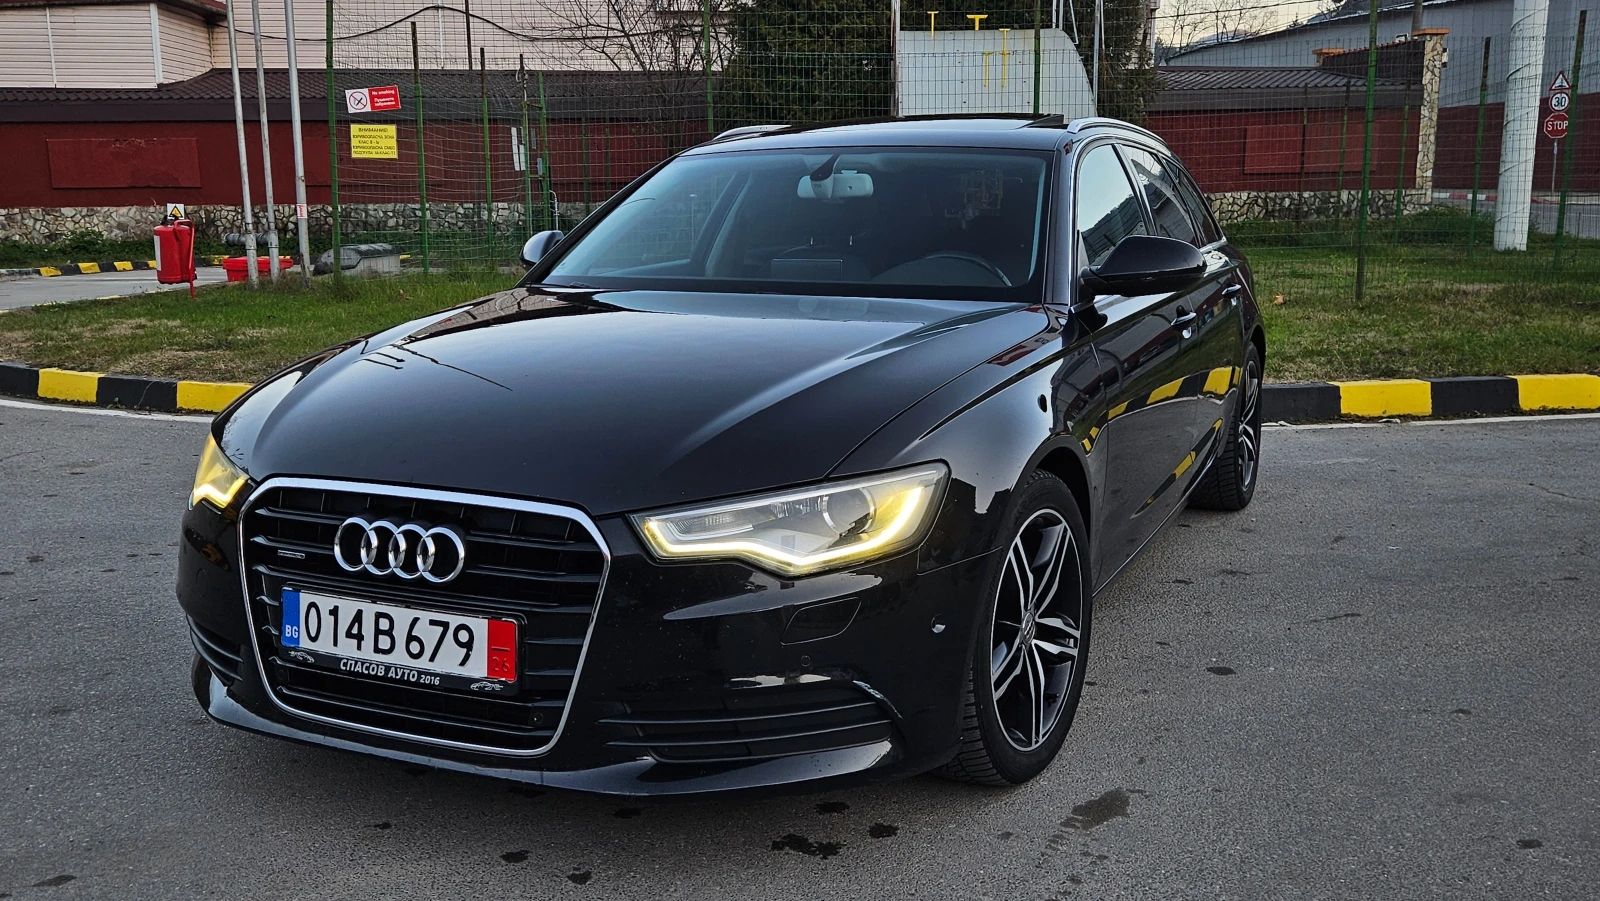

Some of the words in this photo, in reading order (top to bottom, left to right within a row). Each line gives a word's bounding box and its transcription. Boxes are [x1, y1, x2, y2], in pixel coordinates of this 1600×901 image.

[1554, 97, 1566, 107] 30
[1547, 121, 1568, 130] STOP
[286, 625, 299, 638] BG
[305, 601, 475, 667] 014B679
[492, 656, 510, 672] 26
[340, 659, 386, 676] СПАСОВ
[388, 667, 418, 682] АУТО
[420, 675, 440, 685] 2016
